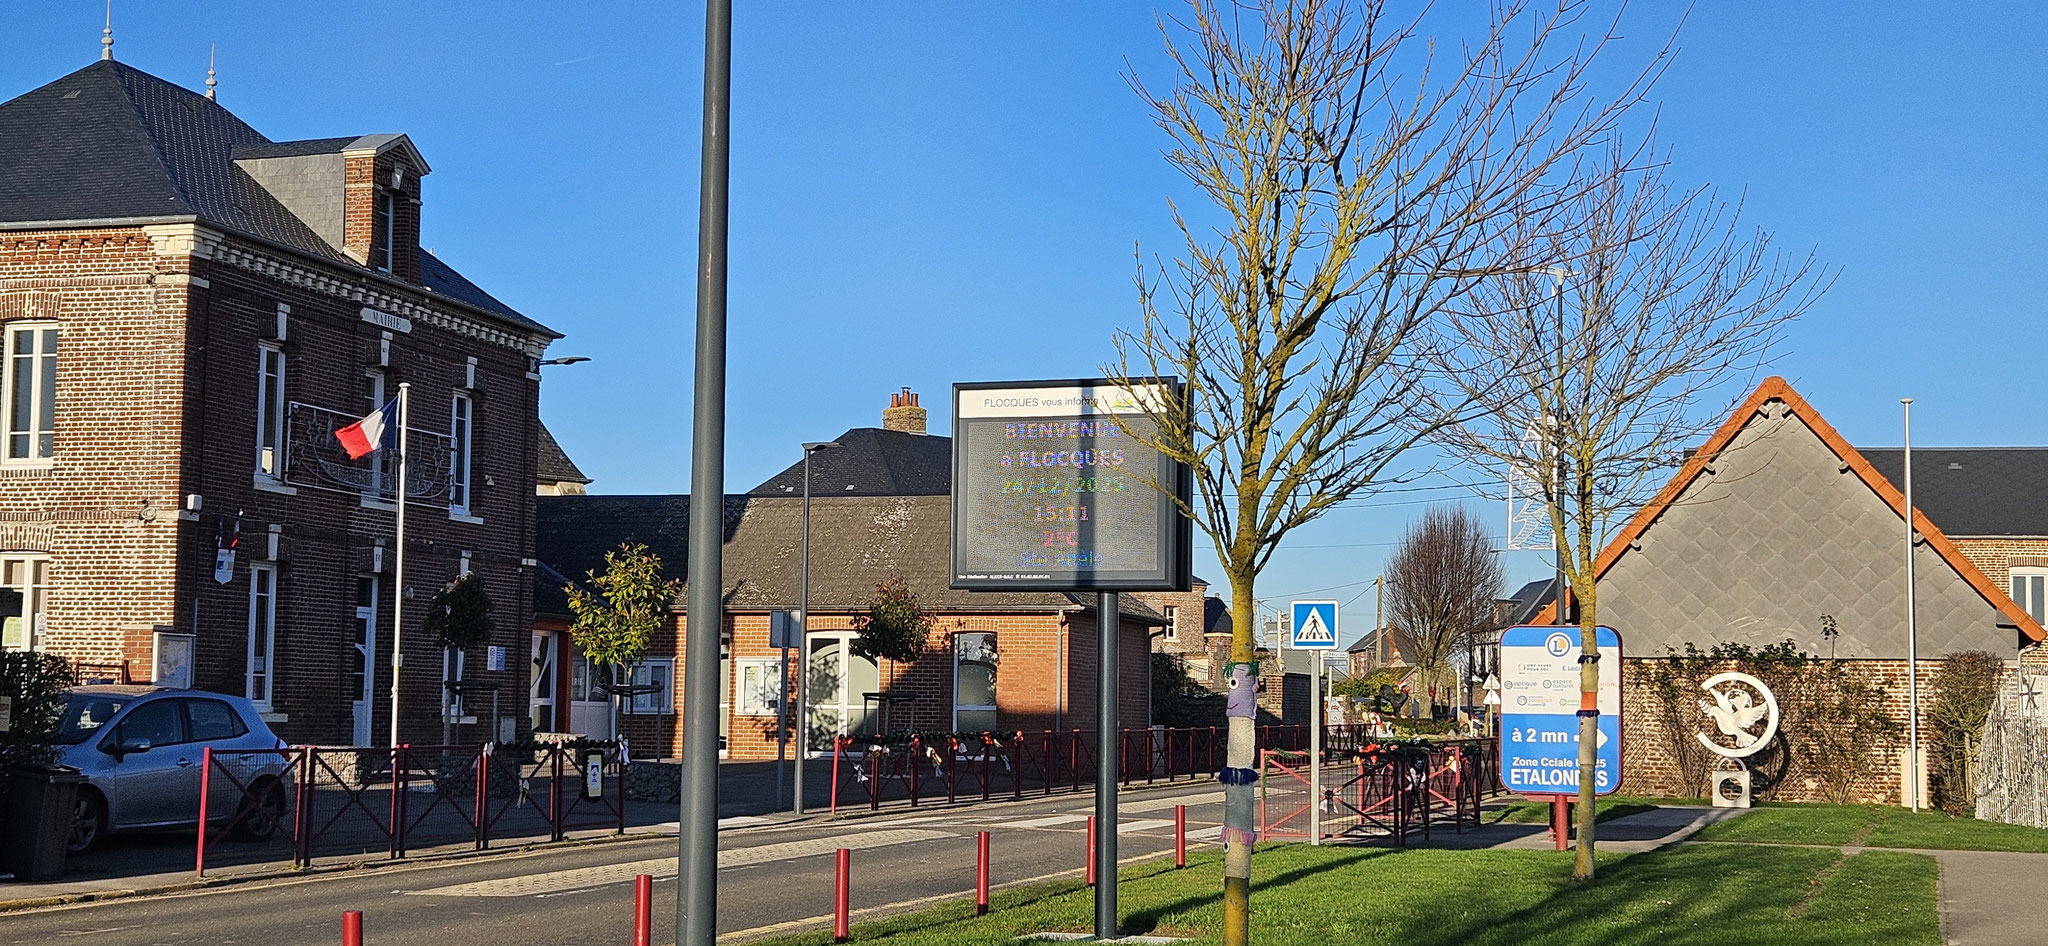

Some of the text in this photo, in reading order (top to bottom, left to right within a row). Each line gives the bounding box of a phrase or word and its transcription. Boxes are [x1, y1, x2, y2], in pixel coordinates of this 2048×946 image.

[373, 311, 402, 330] MAIRIE
[984, 398, 1039, 408] FLOCQUES
[1041, 399, 1063, 407] vous
[1005, 421, 1120, 440] BIENVENUE
[1018, 448, 1124, 469] FLOCQUES
[1553, 640, 1562, 652] L
[1512, 727, 1568, 743] à 2 mn
[1511, 757, 1539, 766] Zone
[1540, 757, 1573, 768] Cciale
[1511, 770, 1608, 786] ETALONS
